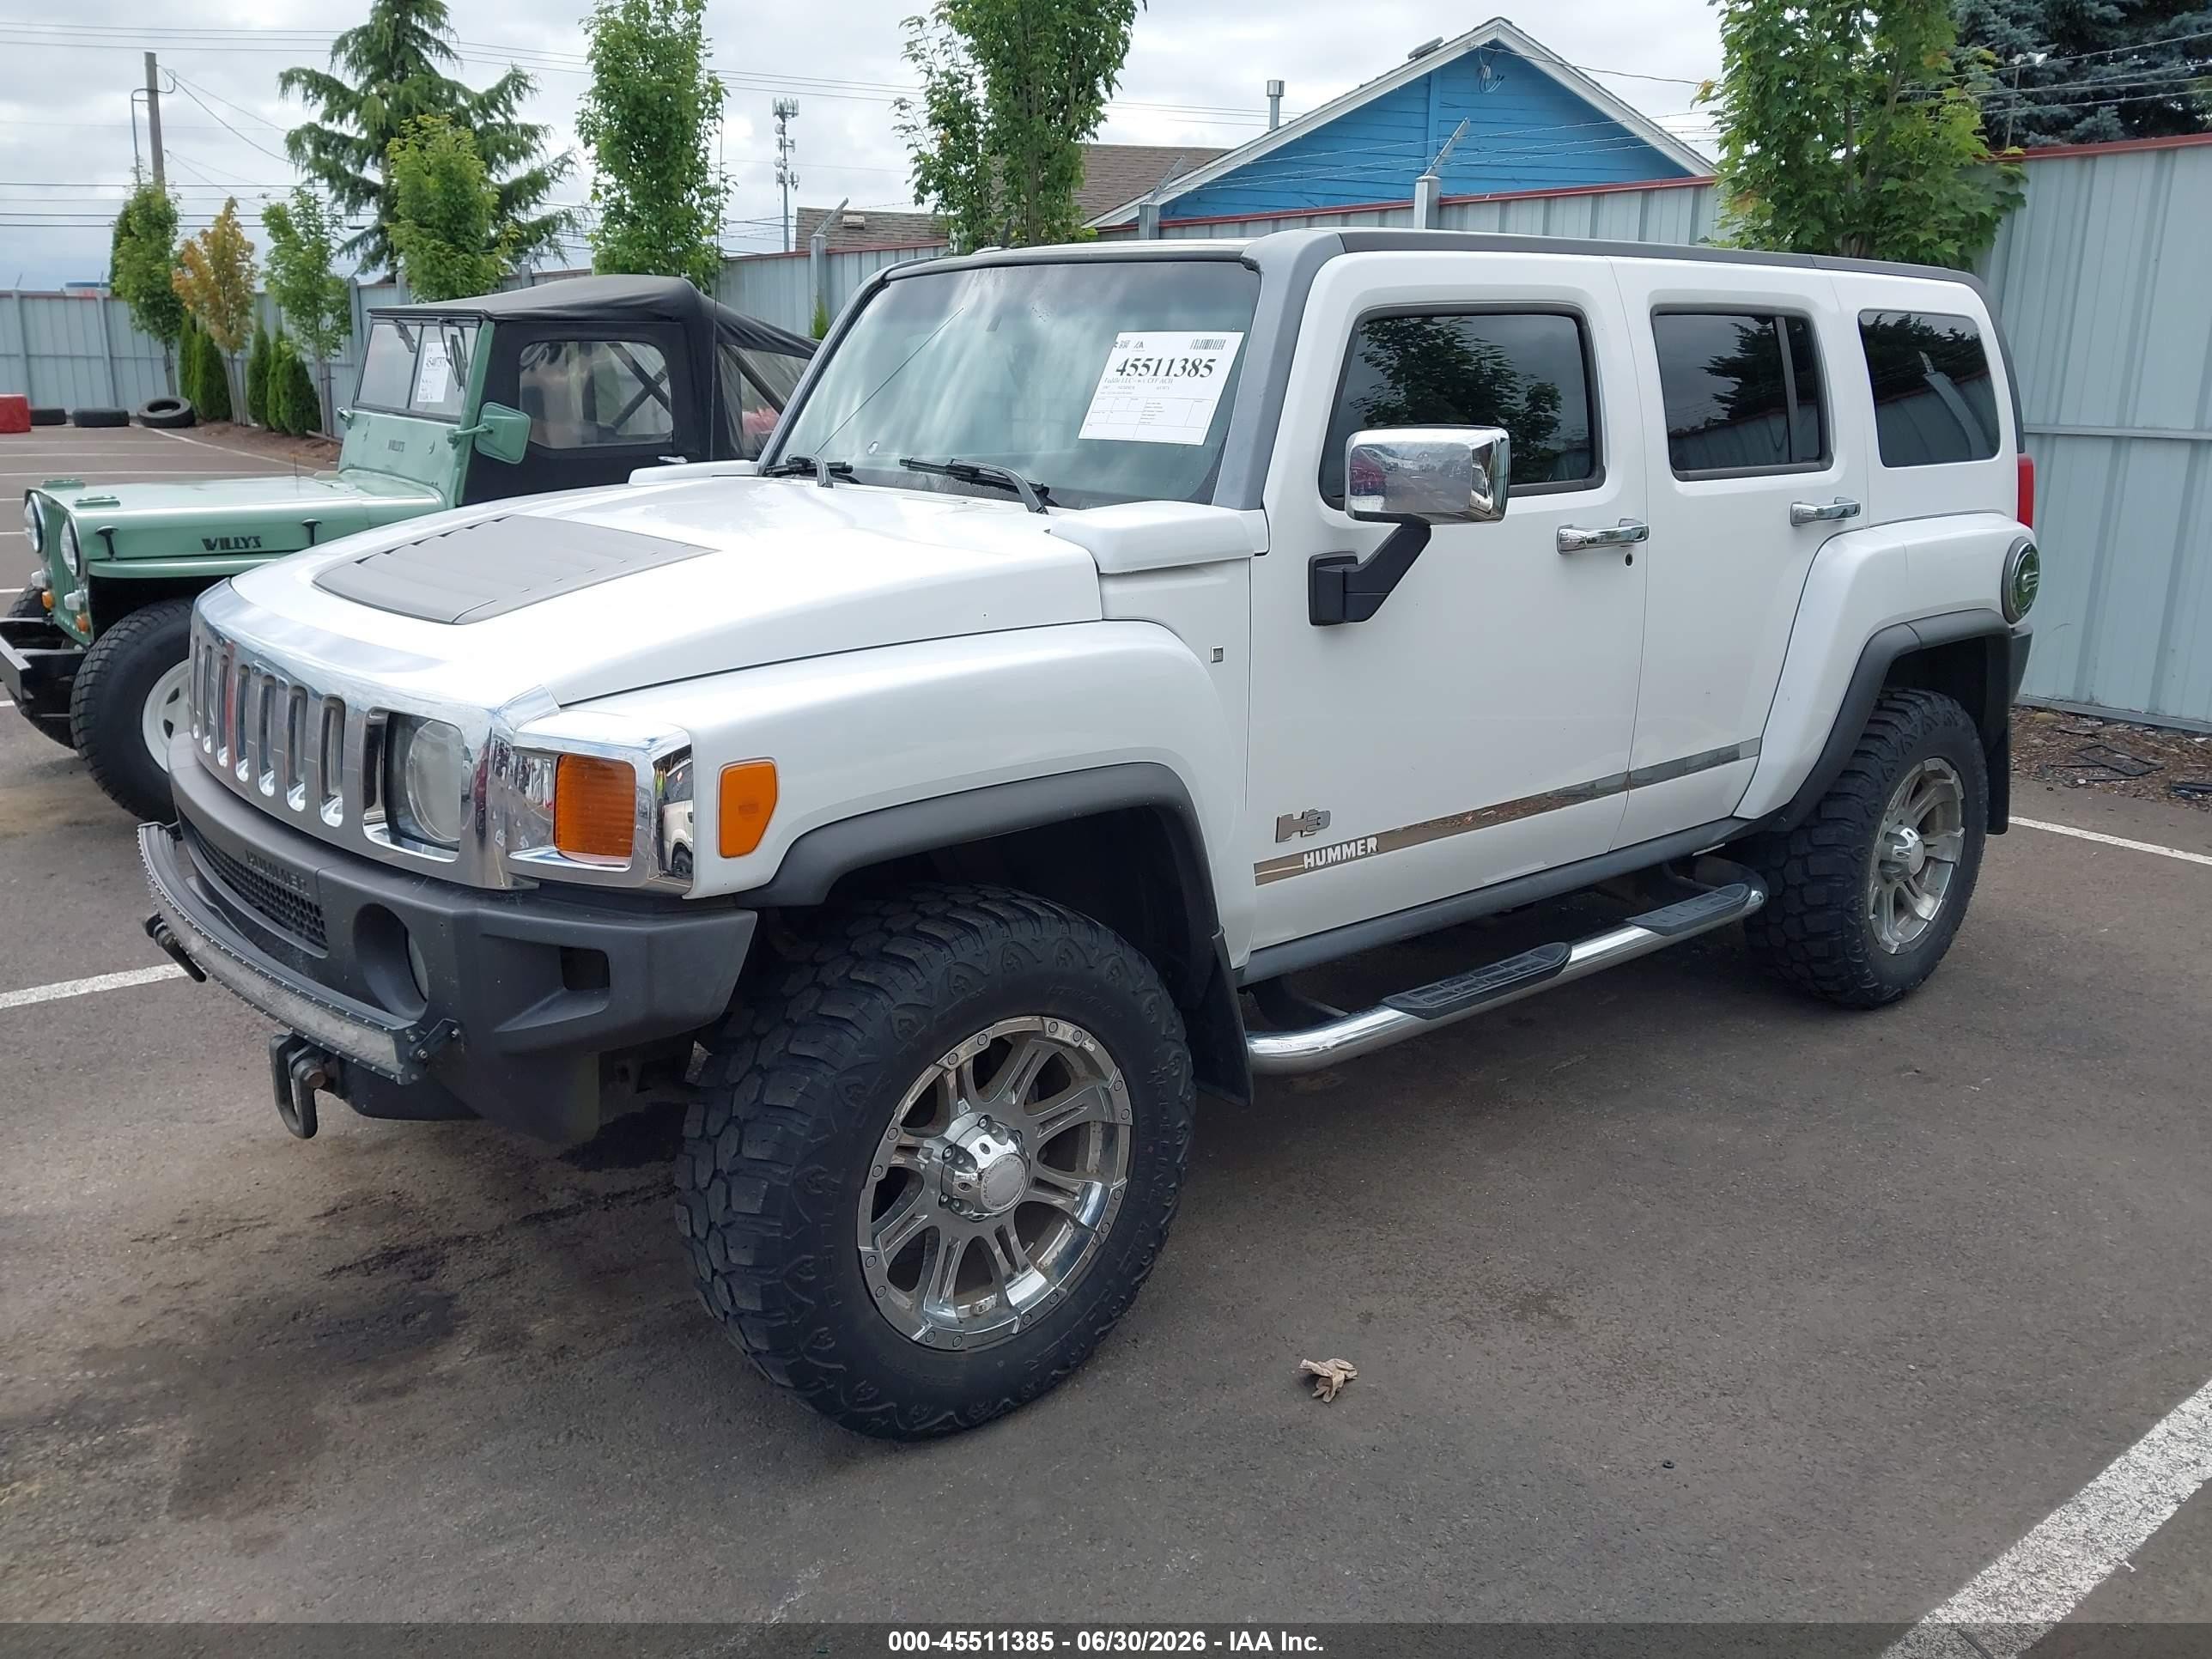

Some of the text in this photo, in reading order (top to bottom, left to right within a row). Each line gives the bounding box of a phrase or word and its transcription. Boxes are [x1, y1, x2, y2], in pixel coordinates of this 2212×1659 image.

[1116, 357, 1216, 378] 45511385
[201, 535, 261, 551] WILLYS
[1276, 808, 1331, 843] H3
[1304, 836, 1379, 869] HUMMER
